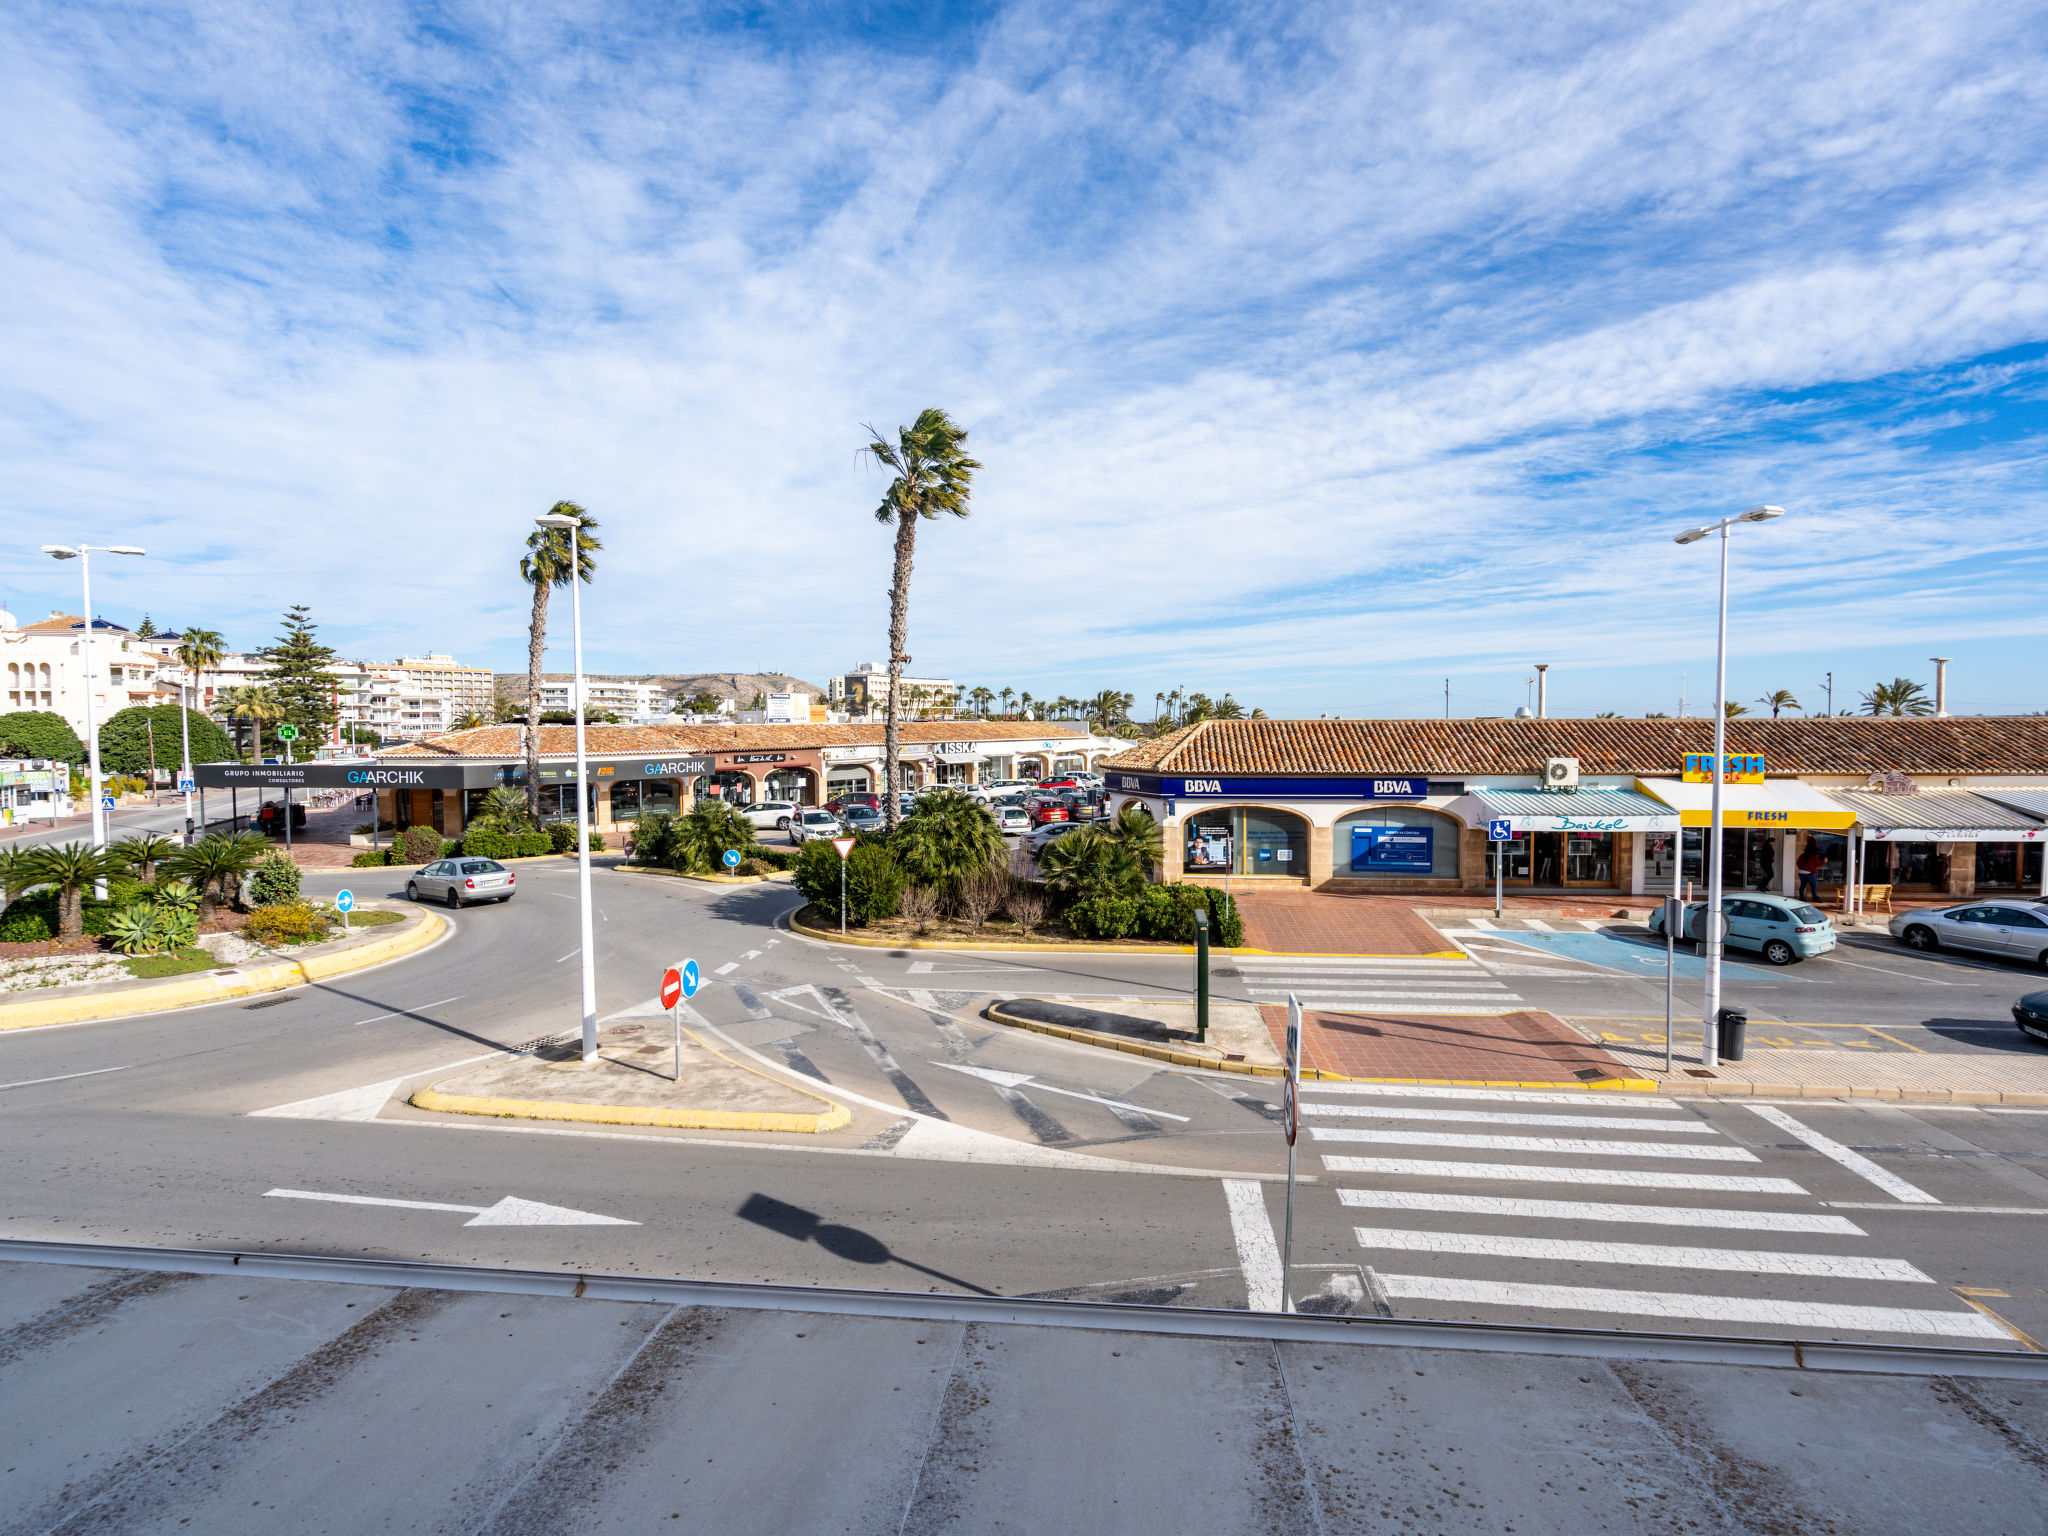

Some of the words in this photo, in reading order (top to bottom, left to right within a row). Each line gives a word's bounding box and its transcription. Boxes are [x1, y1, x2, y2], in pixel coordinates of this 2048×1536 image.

[1686, 755, 1764, 773] FRESH
[1121, 776, 1140, 790] BBVA
[1706, 773, 1743, 781] SOES
[1185, 780, 1222, 792] BBVA
[1374, 780, 1412, 793] BBVA
[1748, 812, 1788, 821] FRESH
[1504, 820, 1510, 828] P
